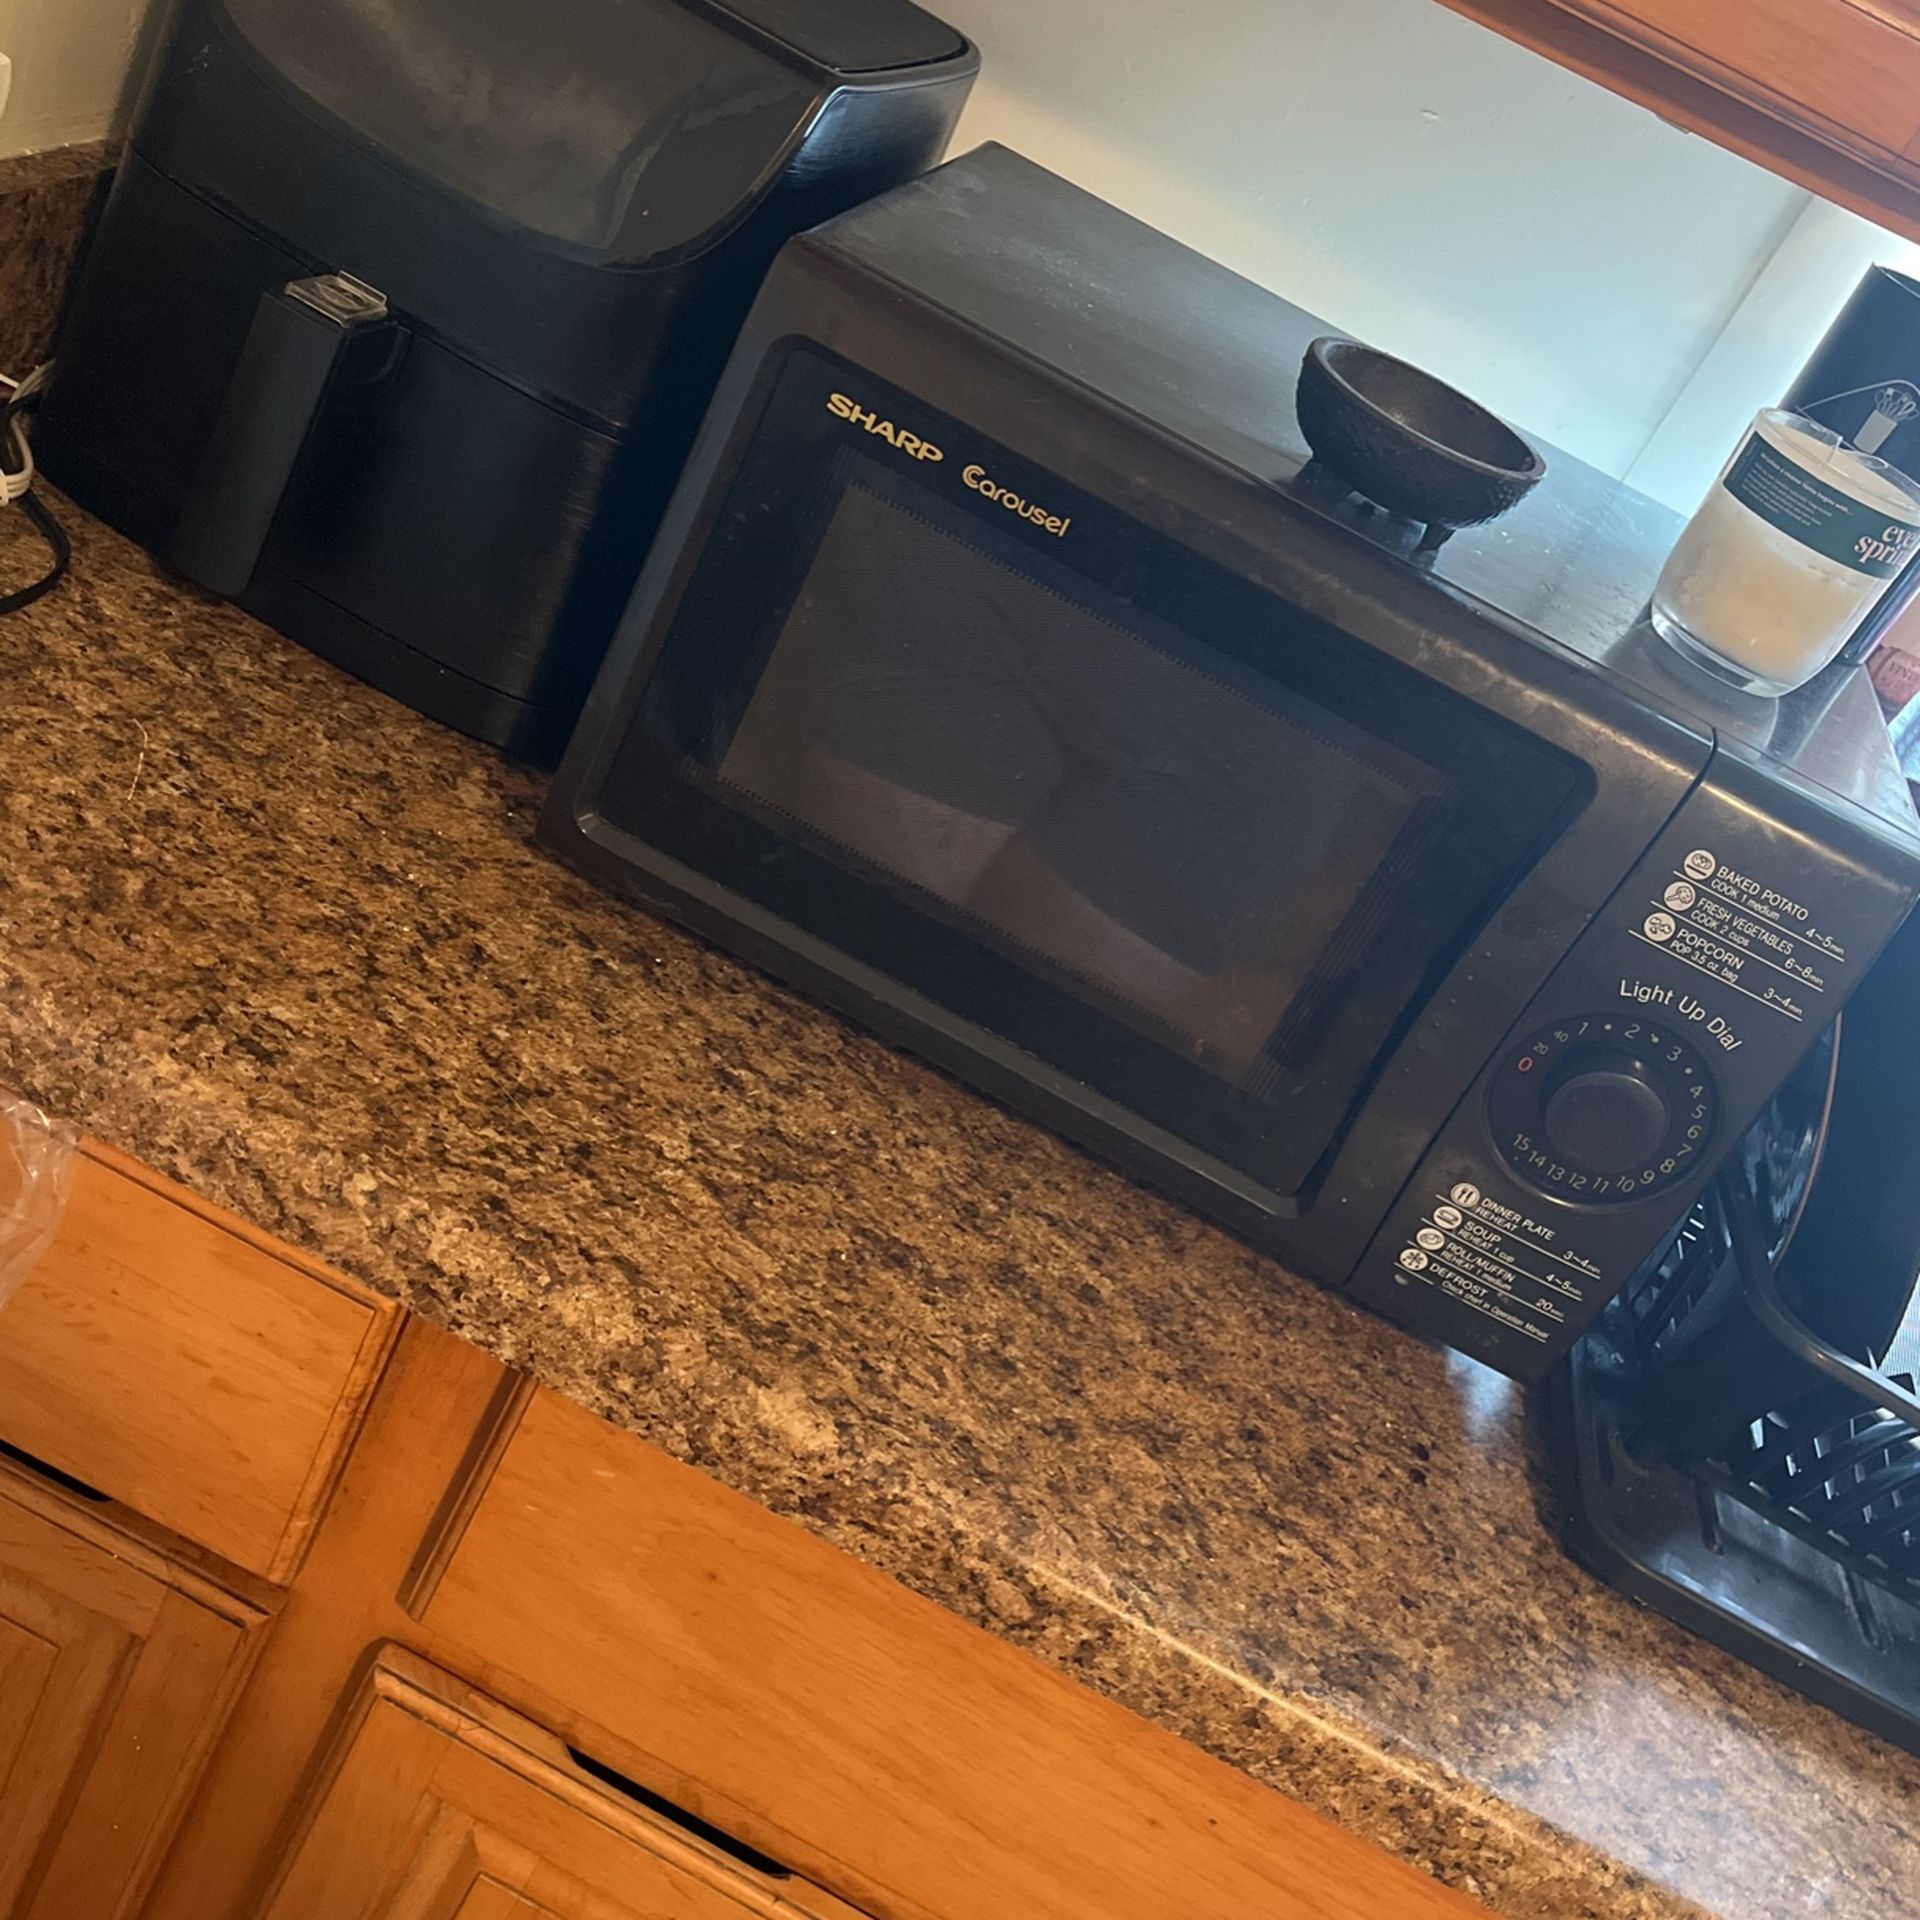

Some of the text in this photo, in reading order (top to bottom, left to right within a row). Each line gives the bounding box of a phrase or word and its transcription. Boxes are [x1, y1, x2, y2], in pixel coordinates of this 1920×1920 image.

[826, 392, 1071, 537] SHARP Carousel
[1711, 879, 1738, 899] COOK
[1747, 898, 1780, 920] medium
[1716, 866, 1808, 921] BAKED POTATO
[1690, 910, 1717, 930] COOK
[1697, 898, 1794, 955] FRESH VEGETABLES
[1670, 940, 1690, 955] POP
[1677, 929, 1744, 970] POPCORN
[1620, 980, 1742, 1051] Light Up Dial
[1513, 1022, 1707, 1193] 0 20 40 1 2 3 4 5 6 7 8 9 10 11 12 13 14 15
[1457, 1228, 1492, 1250] REHEAT
[1464, 1221, 1501, 1243] SOUP
[1475, 1206, 1518, 1232] REHEAT
[1481, 1198, 1555, 1240] DINNER PLATE
[1429, 1263, 1488, 1297] DEFROST
[1440, 1251, 1475, 1271] REHEAT
[1447, 1242, 1515, 1282] ROLL/MUFFIN
